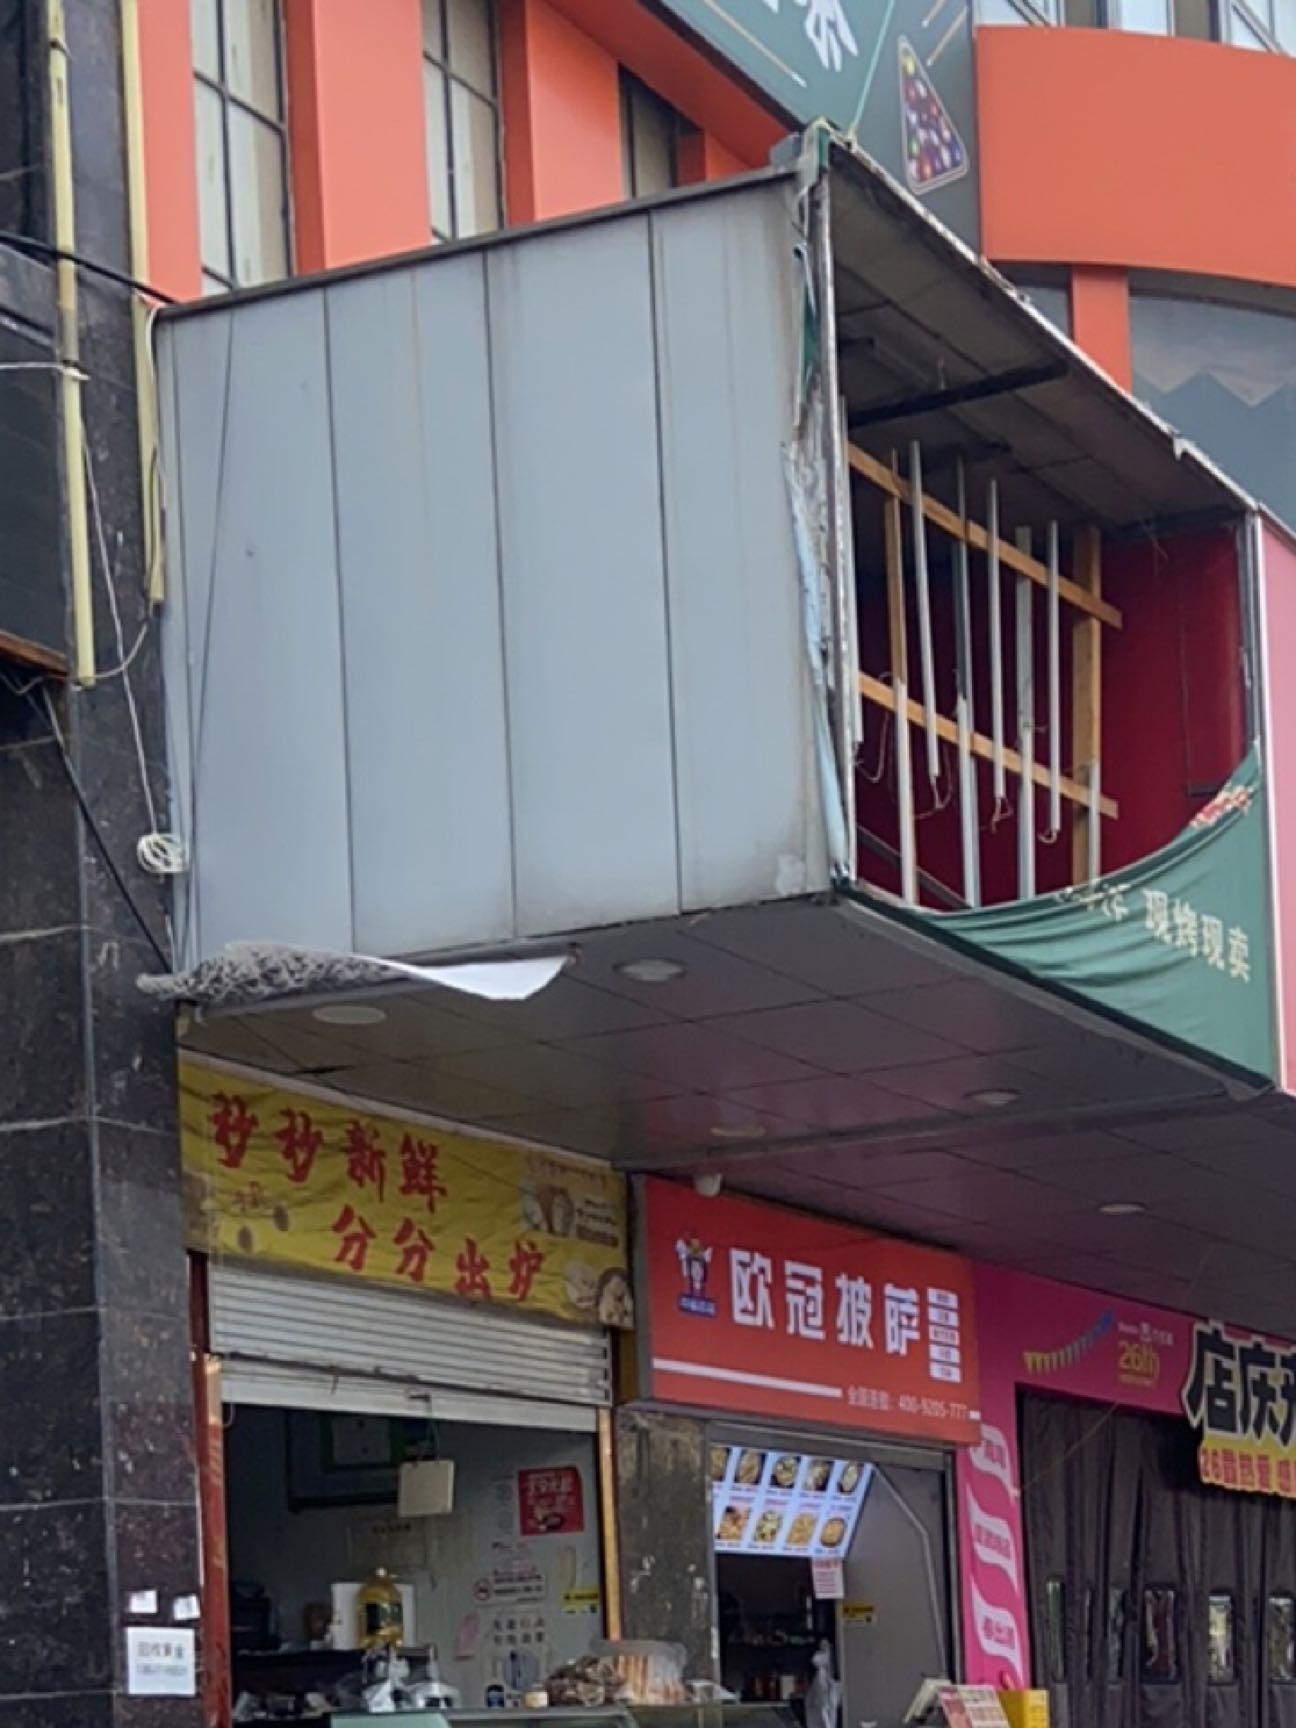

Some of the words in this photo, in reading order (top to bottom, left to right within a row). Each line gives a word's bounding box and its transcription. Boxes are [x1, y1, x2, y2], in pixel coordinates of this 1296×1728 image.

[208, 1090, 448, 1214] 秒秒新鲜
[330, 1203, 546, 1303] 分分出炉
[729, 1247, 920, 1356] 欧冠披萨
